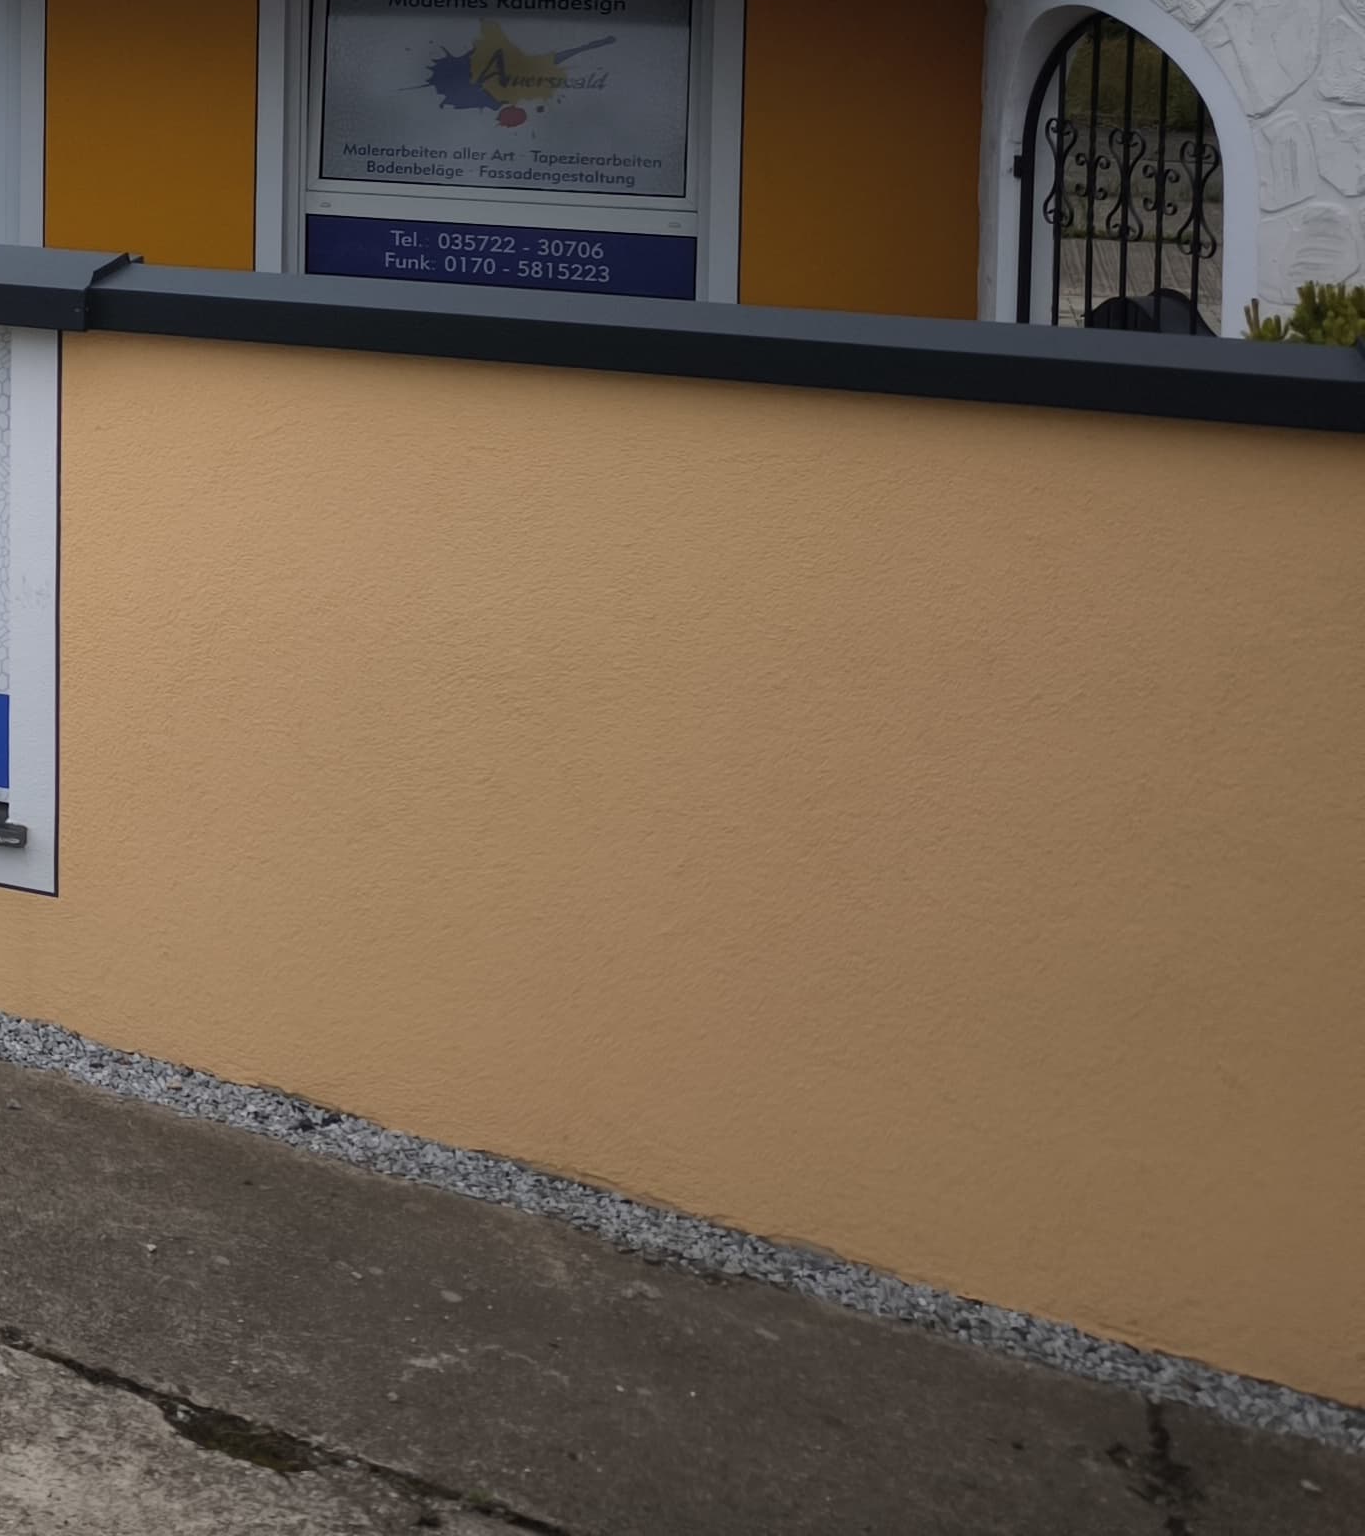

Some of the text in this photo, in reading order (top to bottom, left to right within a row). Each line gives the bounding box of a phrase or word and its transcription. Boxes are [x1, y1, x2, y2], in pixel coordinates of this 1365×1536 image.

[477, 48, 609, 89] Auerswald
[343, 143, 662, 169] Malerarbeiten aller Art Tapezierarbeiten
[366, 160, 635, 188] Bodenbeläge Fassadengestaltung
[438, 232, 516, 253] 035722
[537, 239, 604, 259] 30706
[384, 252, 436, 271] Funk:
[444, 255, 496, 275] 0170
[517, 260, 610, 283] 5815223
